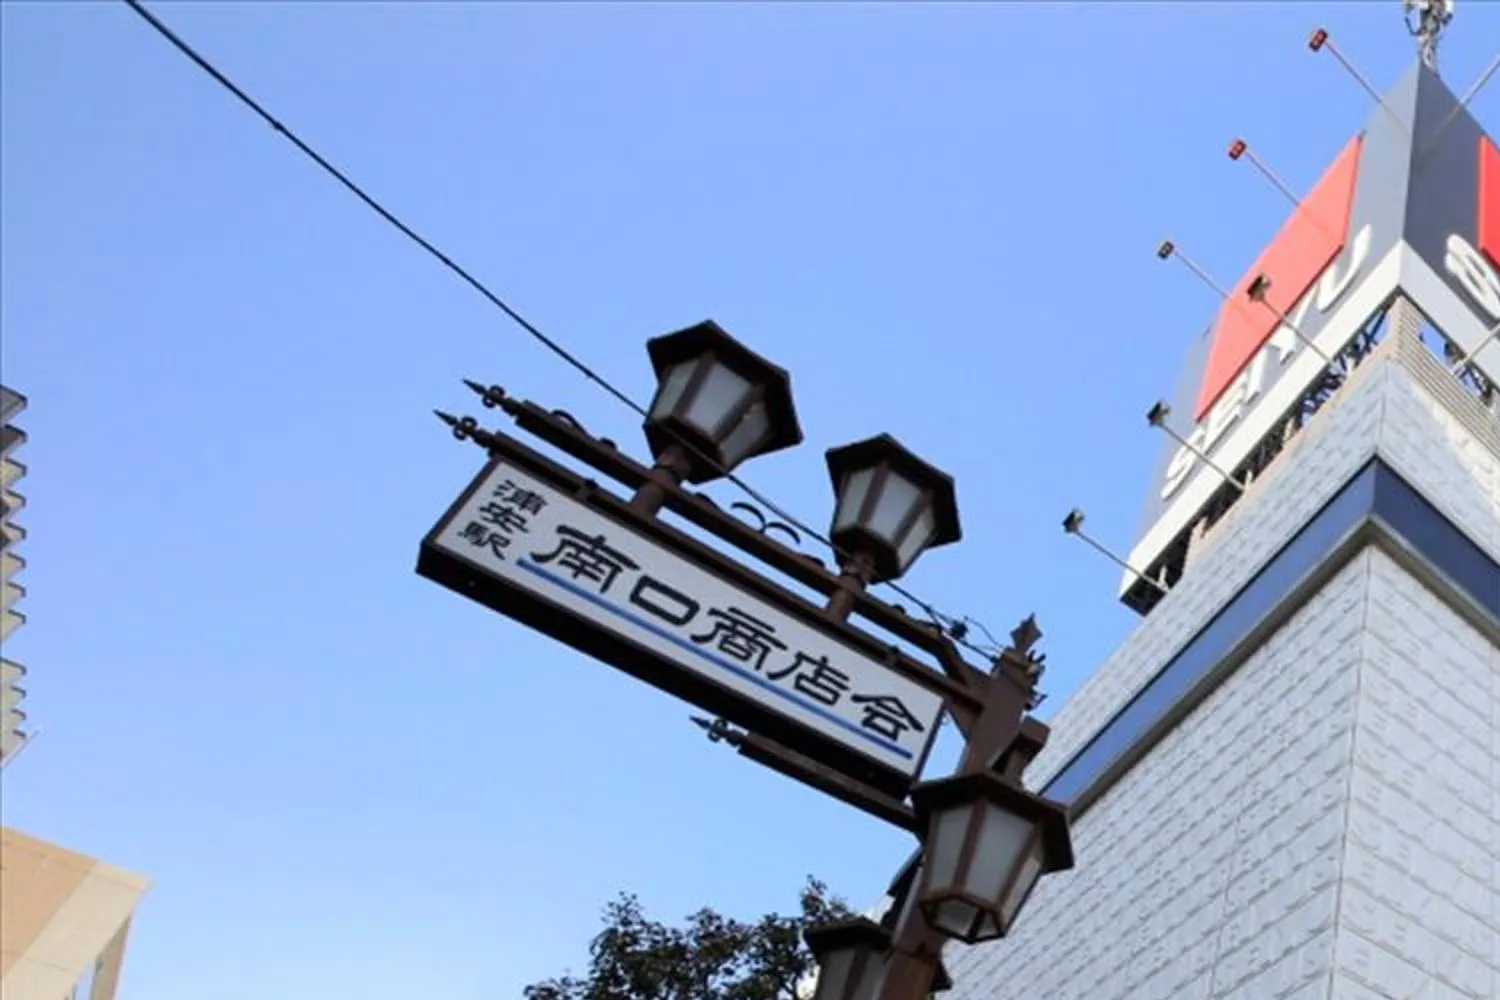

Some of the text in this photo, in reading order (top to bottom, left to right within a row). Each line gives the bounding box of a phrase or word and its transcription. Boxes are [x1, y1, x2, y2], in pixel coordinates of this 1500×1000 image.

[1160, 223, 1371, 500] SEIYU
[457, 479, 548, 560] 浦安駅
[530, 524, 925, 742] 南口商店会
